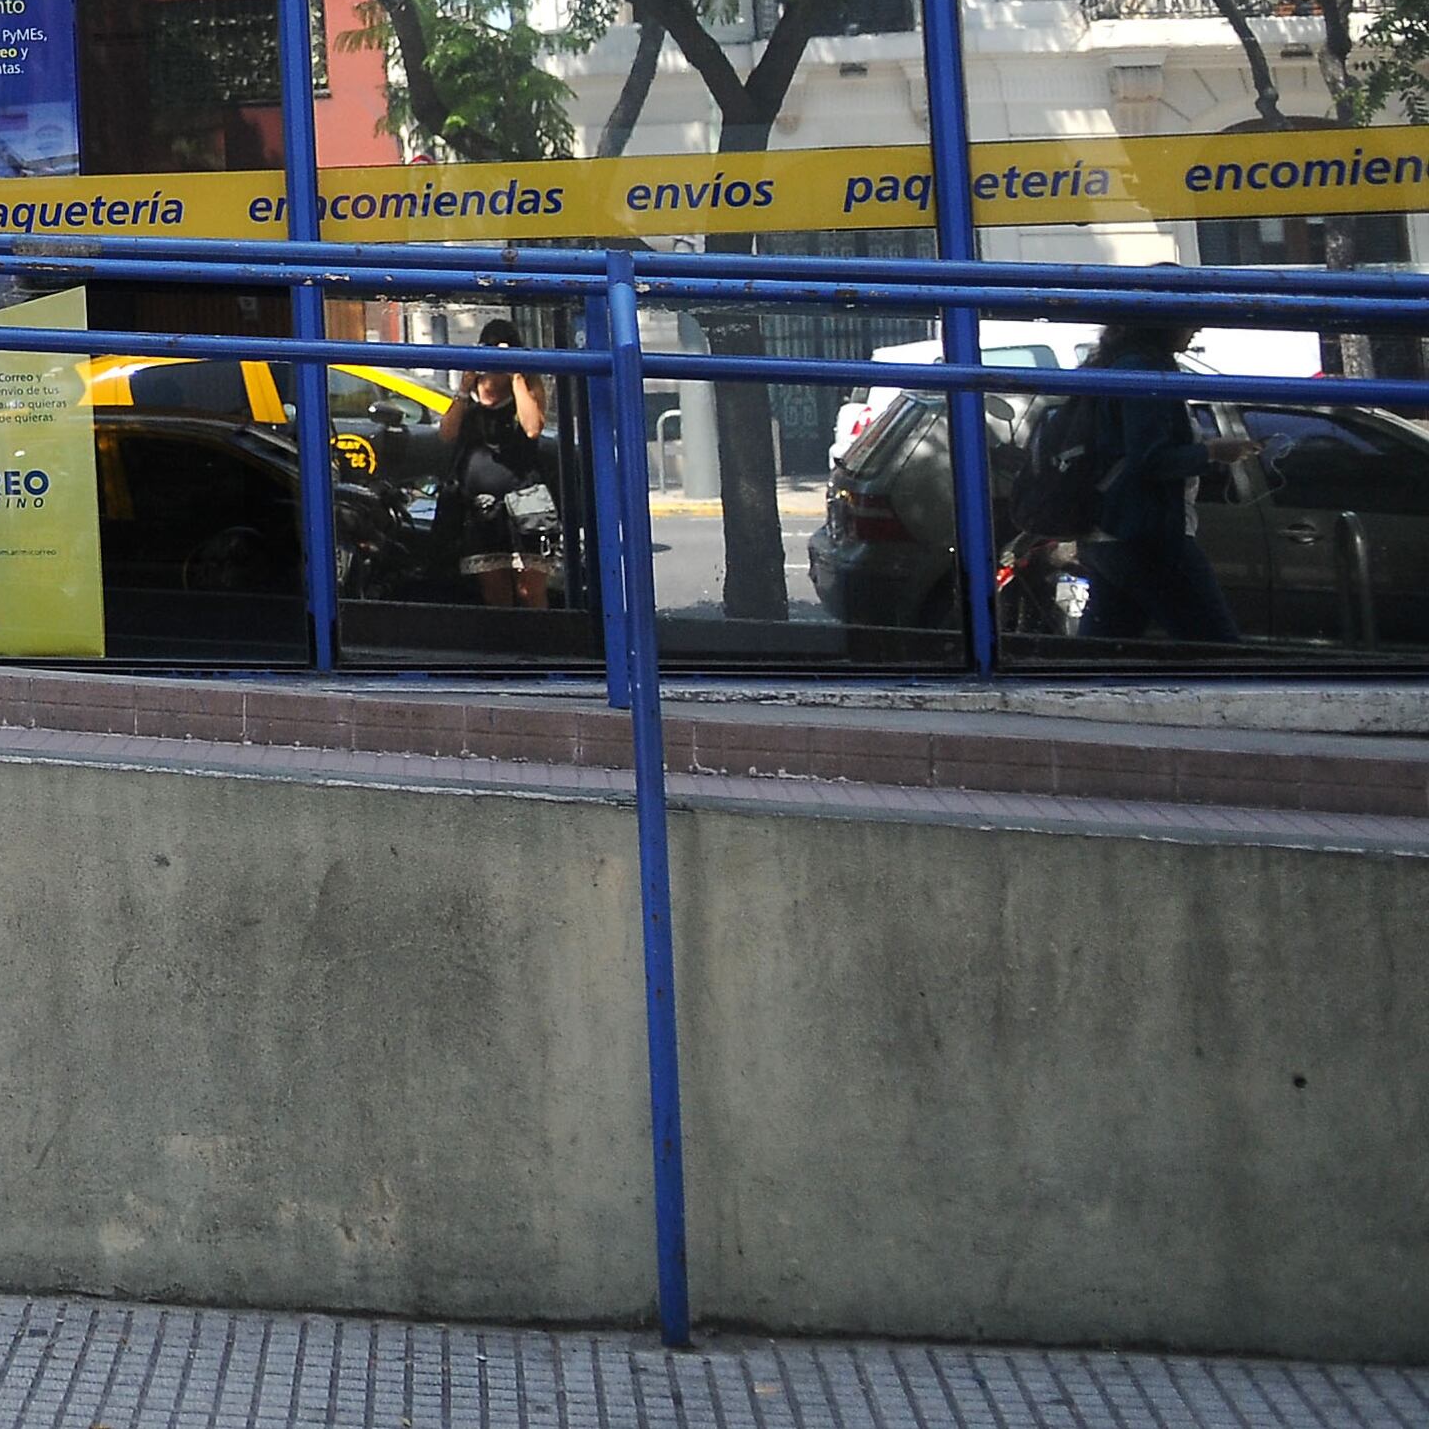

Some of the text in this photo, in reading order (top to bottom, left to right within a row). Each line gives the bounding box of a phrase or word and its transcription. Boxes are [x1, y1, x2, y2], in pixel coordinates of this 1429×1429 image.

[2, 27, 48, 45] PyMEs,
[20, 46, 29, 60] y
[626, 172, 775, 212] envíos
[843, 160, 1110, 213] paqetería
[1185, 148, 1429, 193] encomien
[27, 386, 40, 396] de
[43, 386, 60, 395] tus
[28, 399, 67, 411] quieras
